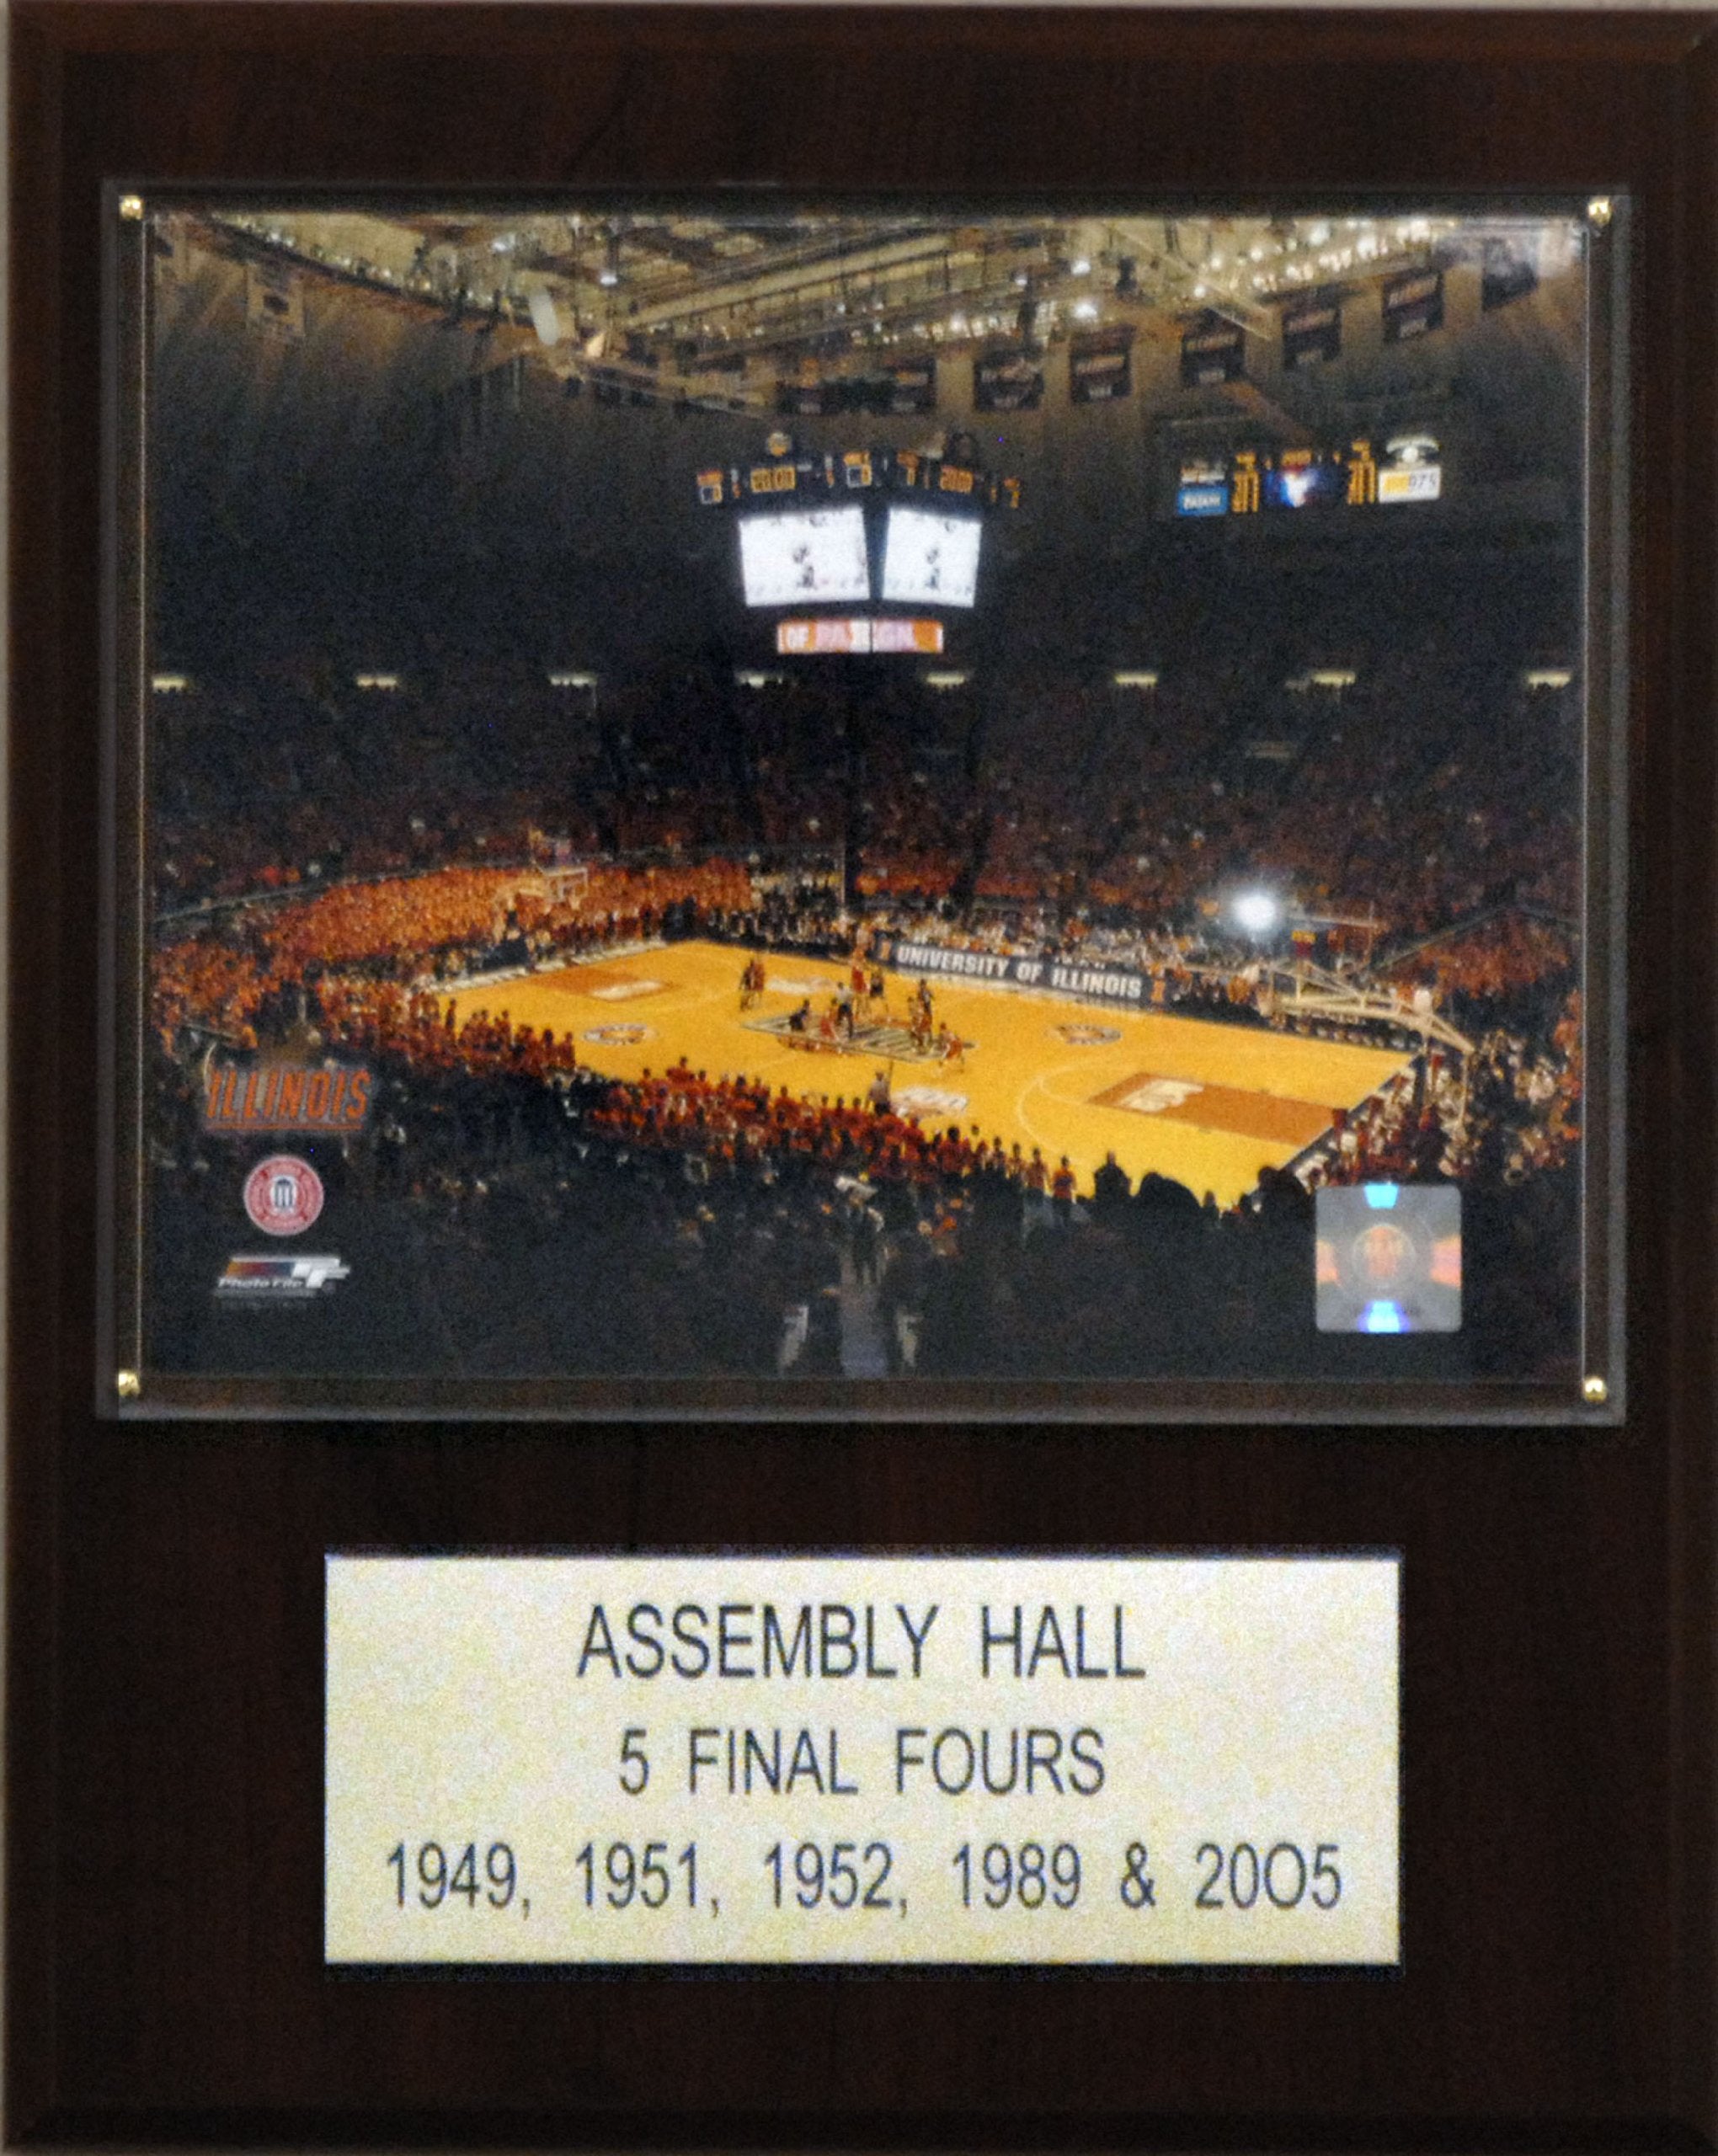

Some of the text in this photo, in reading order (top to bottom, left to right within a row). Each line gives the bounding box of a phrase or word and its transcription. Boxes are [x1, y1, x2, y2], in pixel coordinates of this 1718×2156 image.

[896, 944, 1143, 999] UNIVERSITY OF ILLINOIS
[576, 1602, 1146, 1679] ASSEMBLY HALL
[620, 1726, 1106, 1796] 5 FINAL FOURS
[387, 1841, 531, 1919] 1949,
[575, 1841, 719, 1919] 1951,
[765, 1841, 909, 1919] 1952,
[952, 1841, 1081, 1910] 1989
[1119, 1841, 1156, 1910] &
